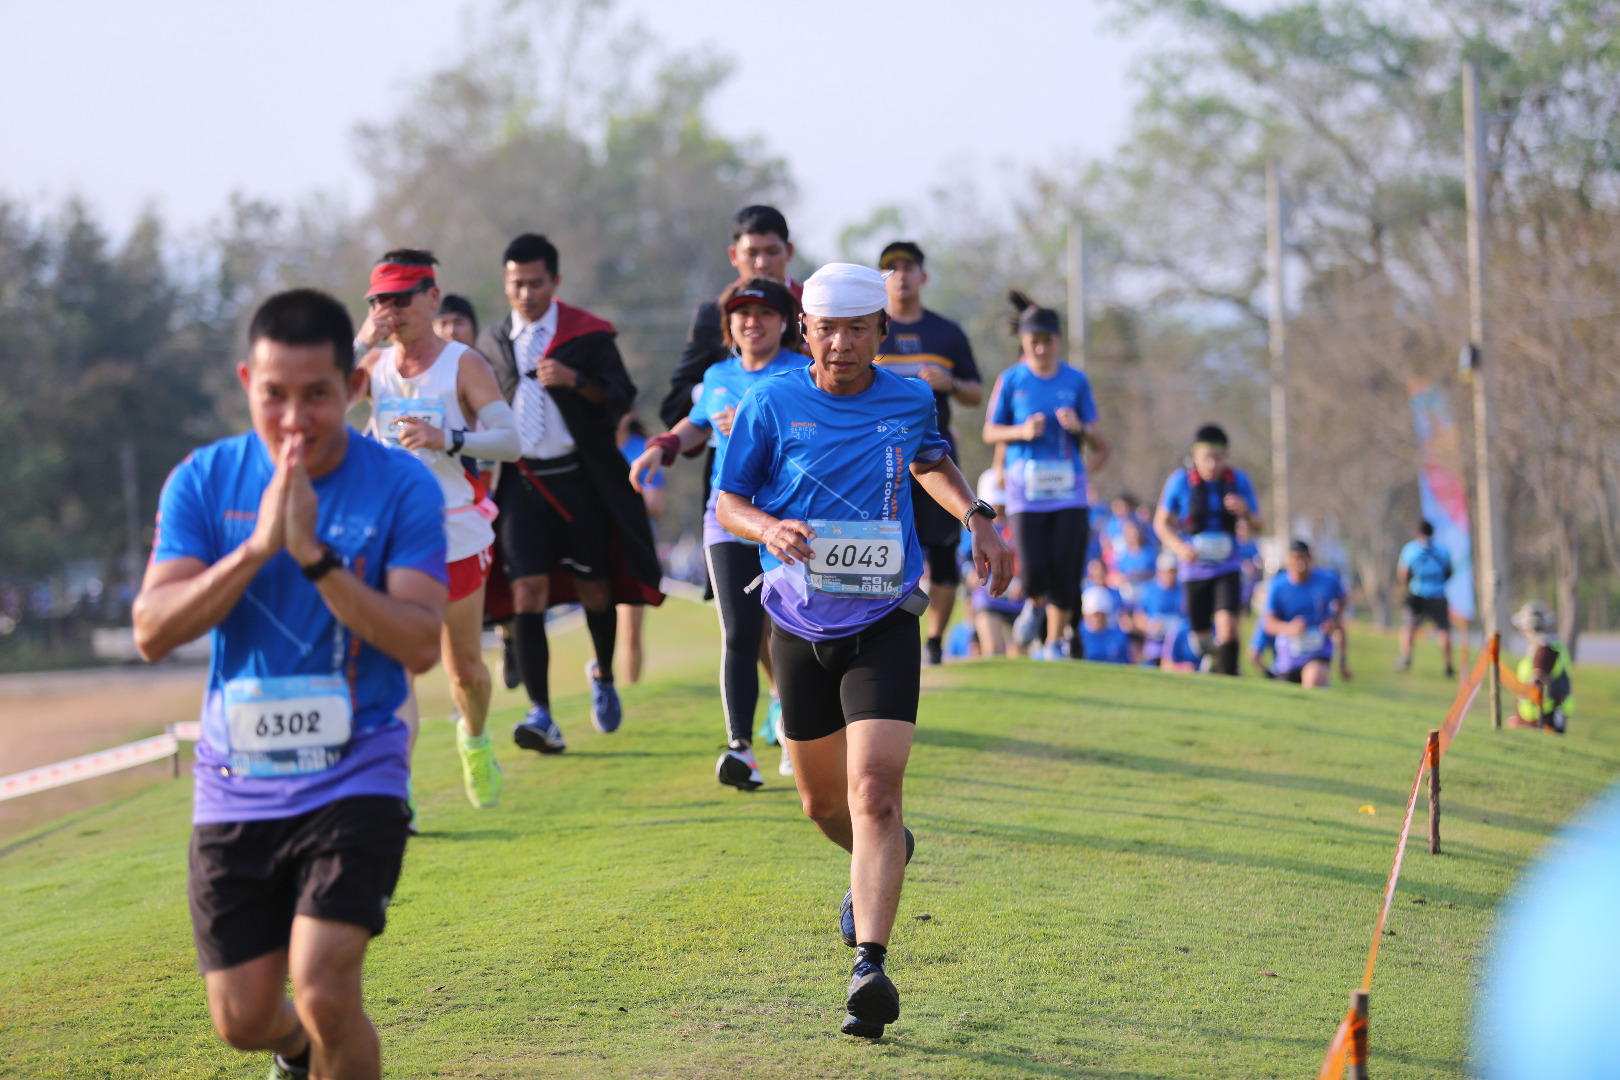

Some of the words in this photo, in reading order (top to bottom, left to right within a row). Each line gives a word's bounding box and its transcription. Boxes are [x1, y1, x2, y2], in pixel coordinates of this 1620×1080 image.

[885, 446, 893, 479] CROSS
[895, 447, 904, 489] SINGHA
[825, 544, 889, 568] 6043
[883, 582, 893, 592] 16
[256, 711, 321, 737] 6302
